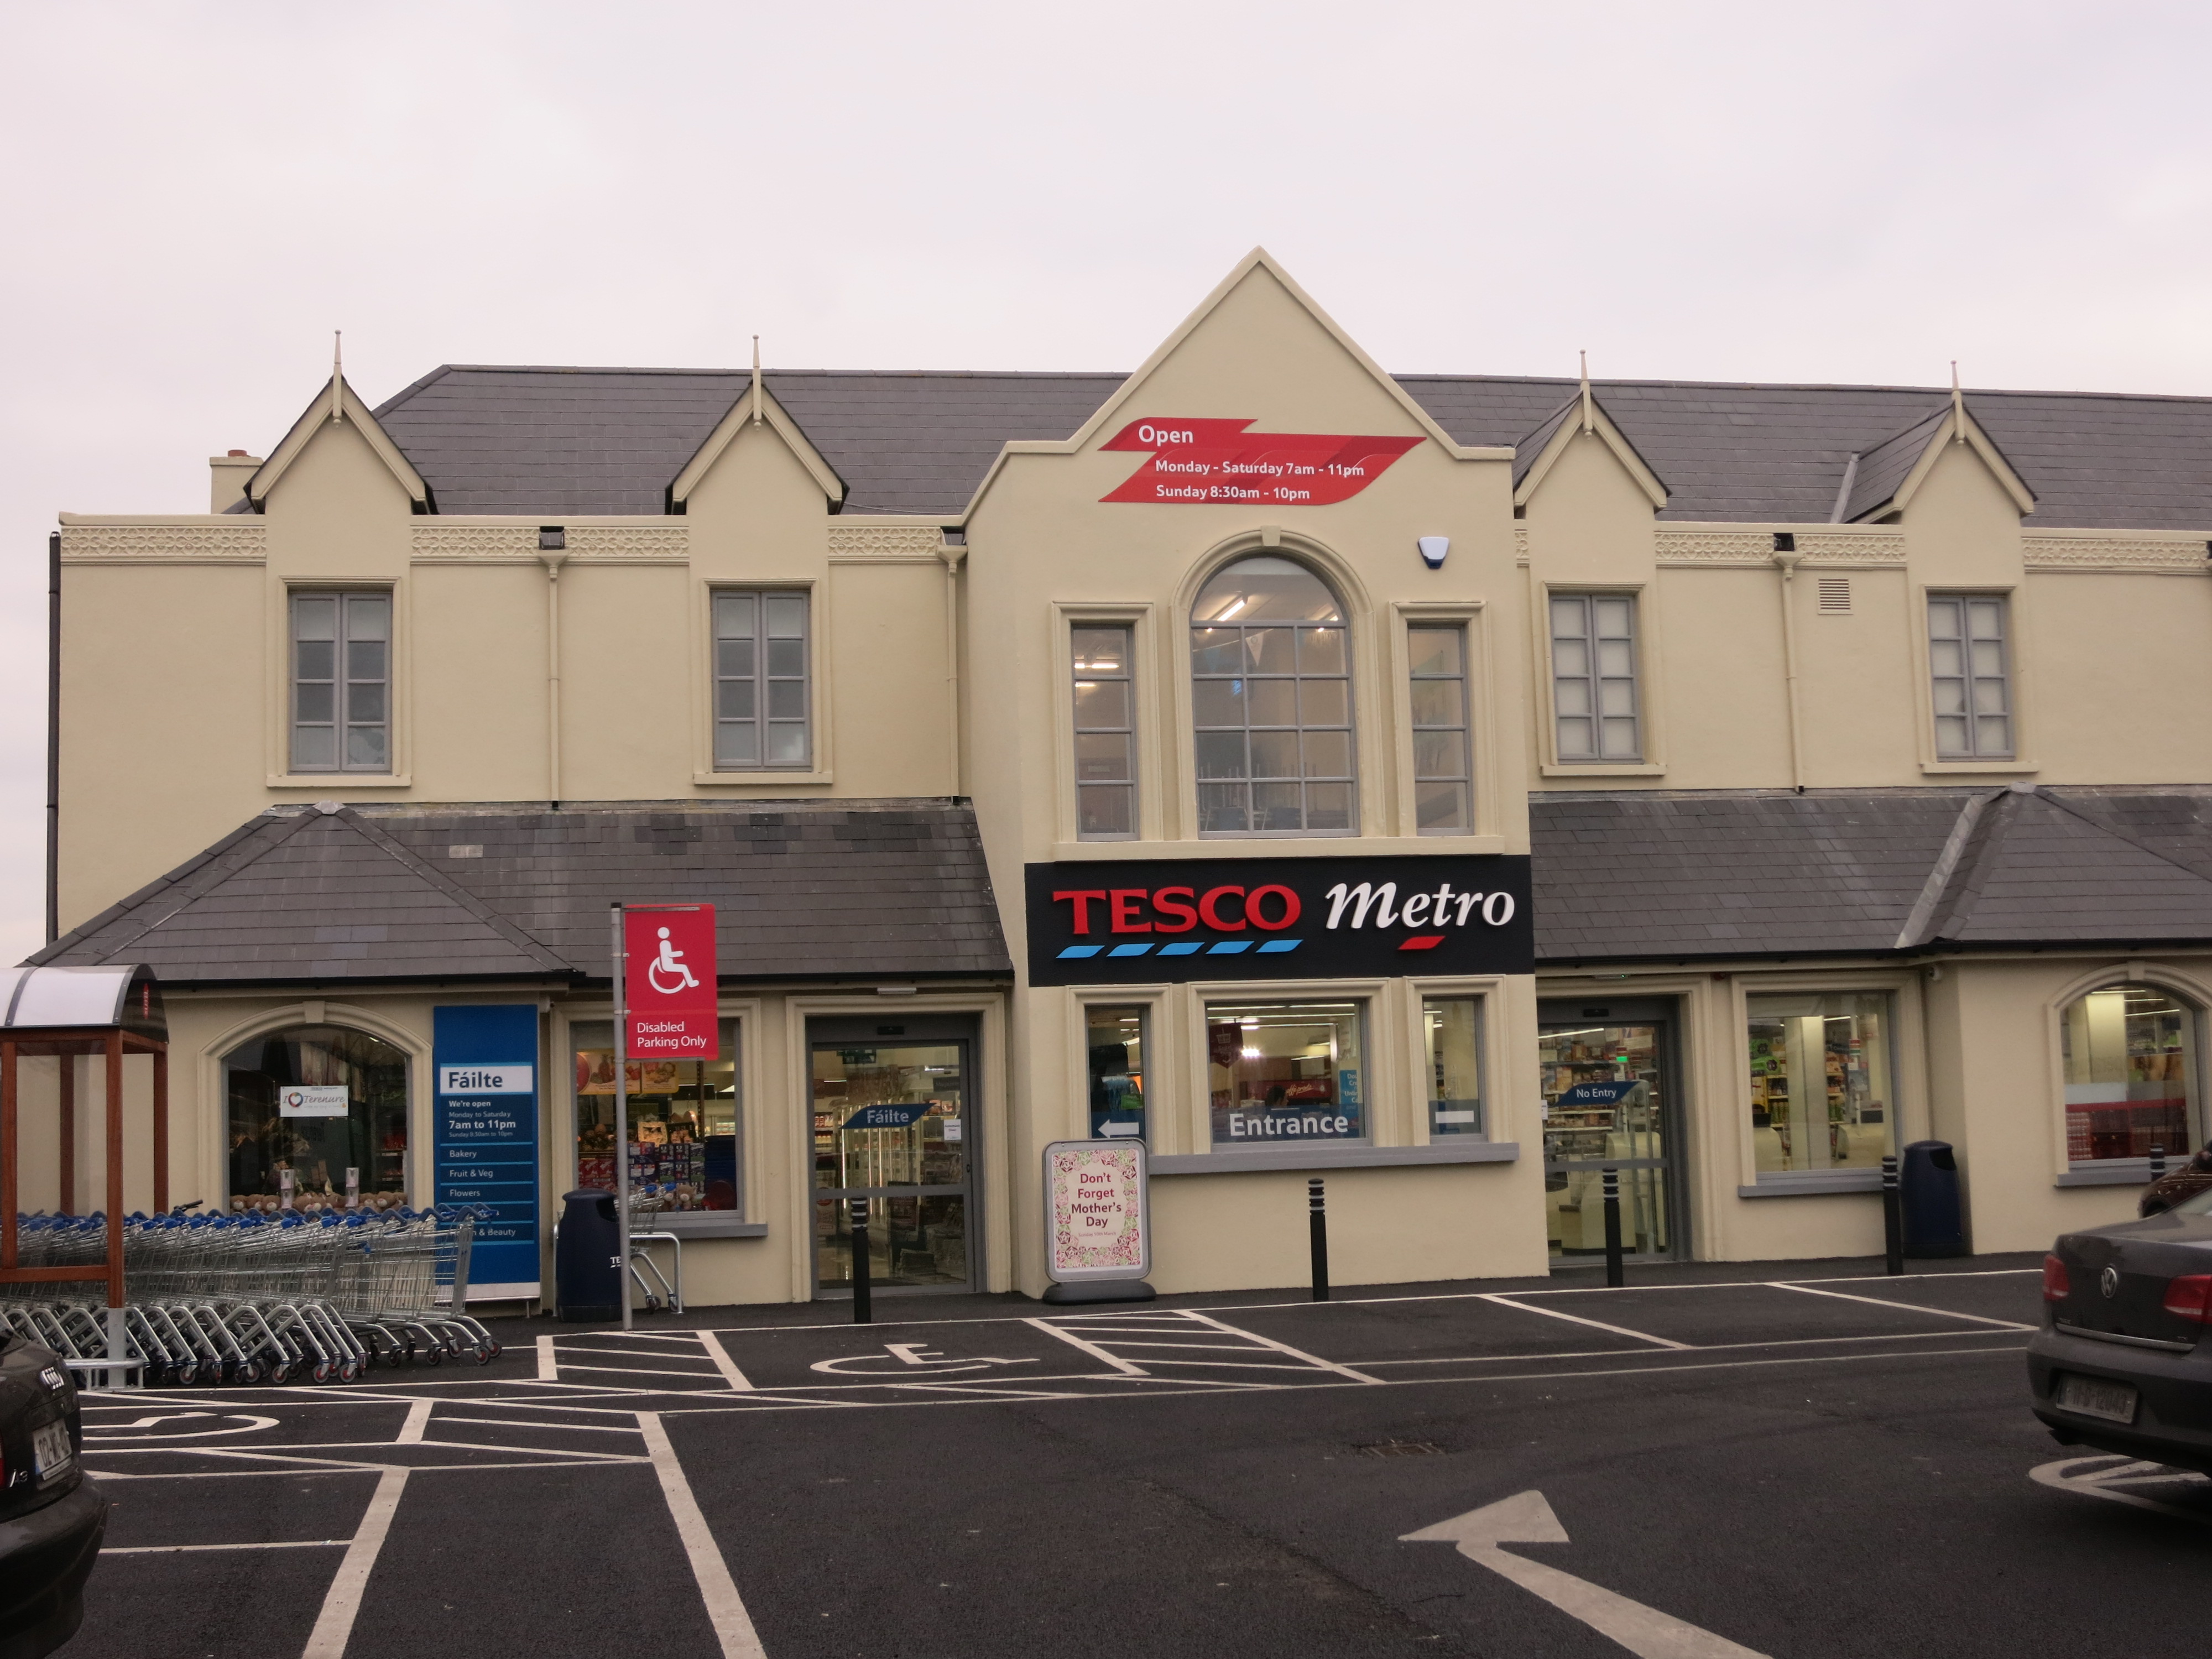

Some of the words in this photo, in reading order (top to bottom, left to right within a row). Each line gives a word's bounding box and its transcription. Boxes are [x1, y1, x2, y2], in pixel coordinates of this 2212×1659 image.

[1138, 425, 1193, 446] Open
[1155, 460, 1210, 474] Monday
[1222, 461, 1283, 477] Saturday
[1286, 463, 1314, 476] 7am
[1327, 463, 1364, 478] 11pm
[1156, 484, 1208, 500] Sunday
[1210, 486, 1260, 499] 8:30am
[1273, 487, 1310, 502] 10pm
[1052, 884, 1302, 935] TESCO
[1324, 881, 1515, 930] Metro
[637, 1021, 685, 1033] Disabled
[638, 1036, 679, 1049] Parking
[681, 1035, 707, 1048] Only
[448, 1071, 503, 1088] Fáilte
[304, 1095, 345, 1104] Terenure
[1576, 1089, 1590, 1098] No
[1593, 1088, 1616, 1099] Entry
[867, 1109, 909, 1124] Fáilte
[449, 1120, 471, 1129] 7am
[488, 1119, 517, 1130] 11pm
[1229, 1113, 1348, 1137] Entrance
[450, 1150, 477, 1159] Bakery
[478, 1169, 493, 1178] Veg
[1080, 1172, 1111, 1183] Don't
[1078, 1188, 1114, 1200] Forget
[1071, 1202, 1121, 1213] Mother's
[1086, 1217, 1108, 1228] Day
[488, 1228, 516, 1237] Beauty
